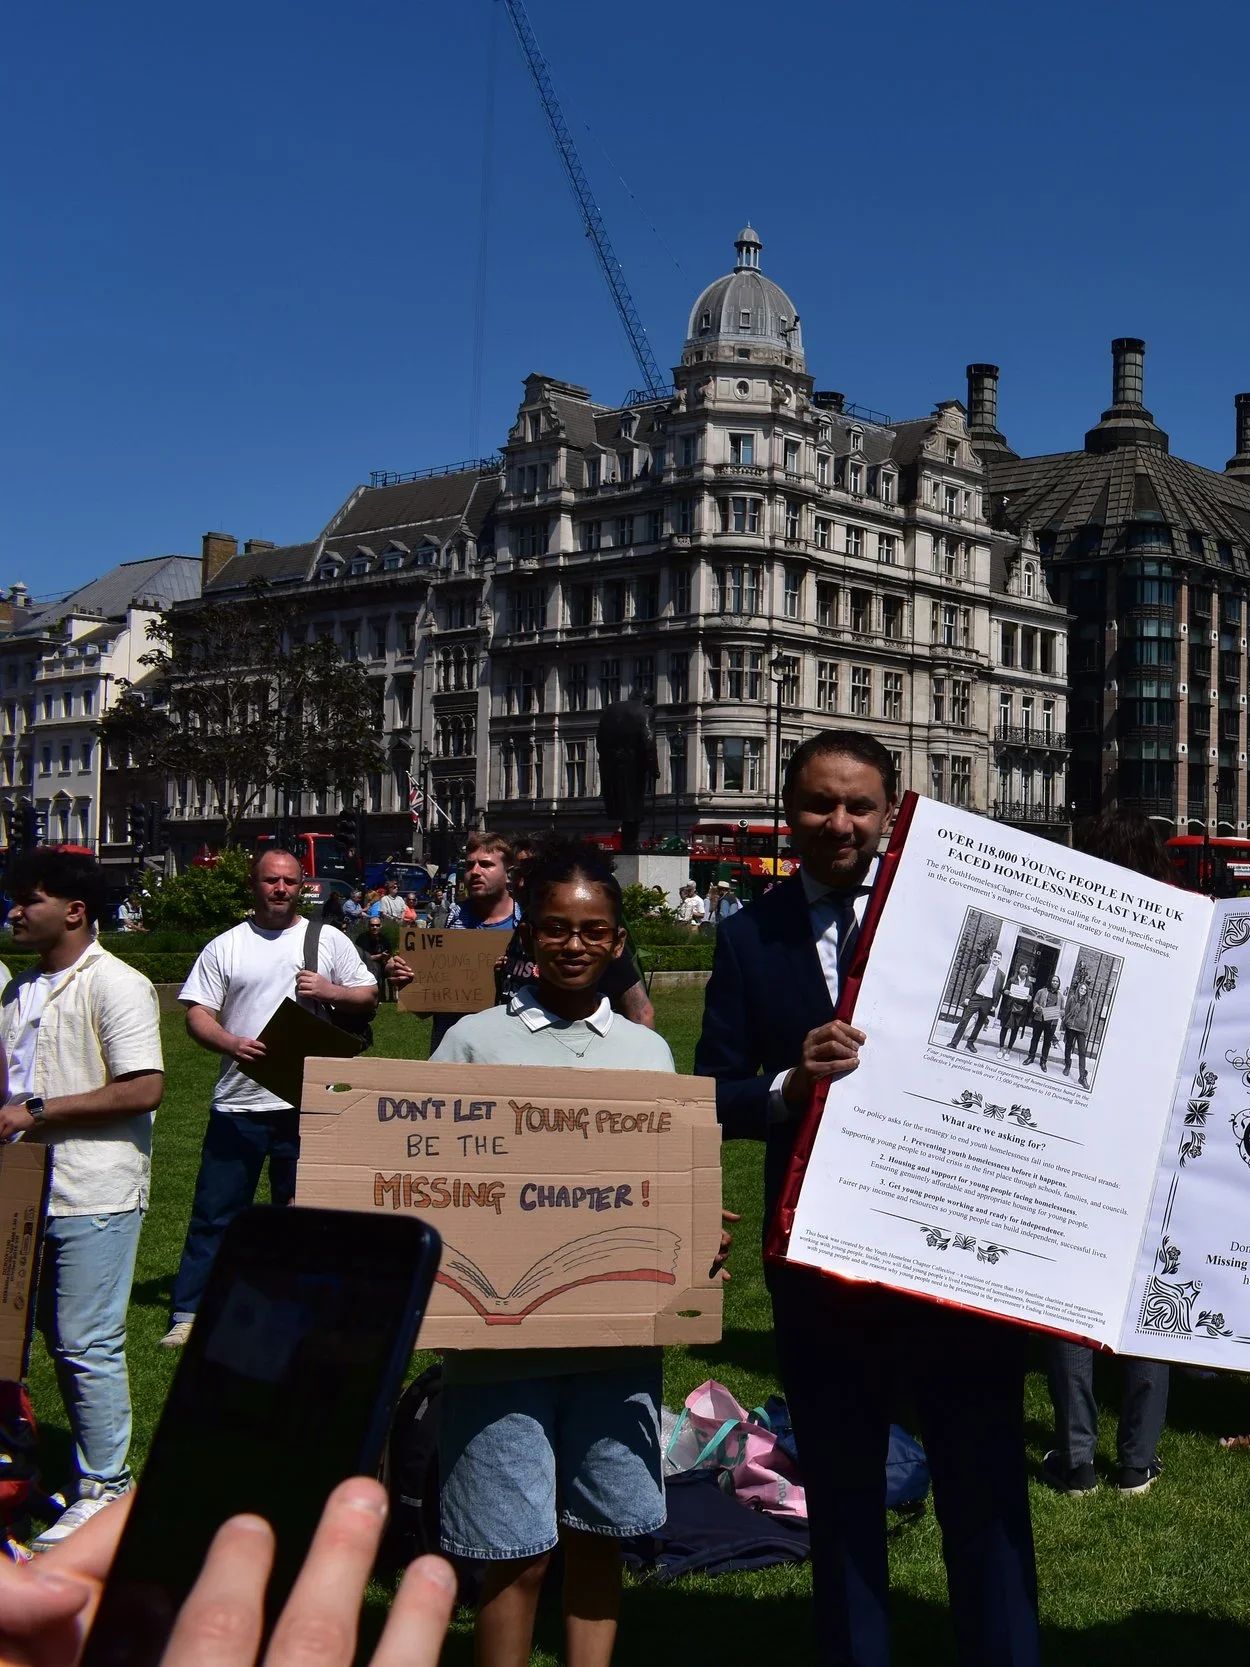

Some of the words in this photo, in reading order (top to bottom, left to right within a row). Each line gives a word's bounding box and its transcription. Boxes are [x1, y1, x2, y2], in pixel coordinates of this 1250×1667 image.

[926, 858, 939, 869] The
[940, 864, 1023, 897] #YouthHomelessChapter
[1024, 893, 1058, 910] Collective
[1066, 909, 1090, 922] calling
[1091, 915, 1101, 924] for
[1107, 923, 1153, 942] youth-specific
[1154, 938, 1178, 950] chapter
[937, 828, 974, 848] OVER
[978, 842, 1017, 863] 118,000
[1021, 856, 1066, 880] YOUNG
[1068, 874, 1117, 898] PEOPLE
[1120, 892, 1134, 904] IN
[1137, 897, 1162, 914] THE
[1165, 907, 1183, 921] UK
[948, 847, 990, 869] FACED
[994, 864, 1094, 906] HOMELESSNESS
[1097, 900, 1129, 917] LAST
[1132, 911, 1165, 930] YEAR
[927, 869, 935, 878] in
[936, 873, 947, 882] the
[996, 895, 1012, 904] new
[1012, 901, 1075, 926] cross-departmental
[1076, 922, 1103, 936] strategy
[1111, 934, 1125, 943] end
[1125, 937, 1170, 958] homelessness.
[430, 953, 471, 969] YOUNG
[422, 988, 484, 1001] THRIVE
[378, 1097, 445, 1122] DON'T
[454, 1100, 496, 1122] LET
[507, 1100, 589, 1139] YOUNG
[595, 1110, 672, 1134] PEOPLE
[406, 1134, 440, 1158] BE
[457, 1135, 509, 1157] THE
[853, 1105, 866, 1114] Our
[866, 1110, 886, 1121] policy
[887, 1117, 901, 1125] asks
[902, 1119, 912, 1128] for
[913, 1123, 923, 1131] the
[924, 1127, 949, 1139] strategy
[969, 1140, 988, 1150] youth
[988, 1144, 1029, 1162] homelessness
[1030, 1156, 1042, 1165] fall
[1042, 1159, 1055, 1169] into
[1055, 1164, 1071, 1174] three
[1071, 1170, 1097, 1182] practical
[1098, 1178, 1121, 1189] strands:
[941, 1113, 965, 1127] What
[966, 1123, 981, 1132] are
[983, 1128, 996, 1136] we
[997, 1132, 1026, 1147] asking
[1027, 1139, 1046, 1151] for?
[841, 1127, 876, 1143] Supporting
[876, 1138, 897, 1149] young
[897, 1144, 919, 1154] people
[927, 1153, 946, 1162] avoid
[945, 1158, 963, 1167] crisis
[963, 1161, 971, 1170] in
[971, 1164, 982, 1173] the
[982, 1167, 995, 1176] first
[995, 1172, 1013, 1181] place
[1013, 1176, 1037, 1189] through
[1038, 1185, 1062, 1197] schools,
[1063, 1191, 1089, 1205] families,
[1089, 1200, 1102, 1208] and
[1102, 1204, 1129, 1215] councils.
[888, 1156, 916, 1170] Housing
[916, 1165, 930, 1173] and
[931, 1169, 957, 1181] support
[958, 1175, 968, 1184] for
[968, 1180, 990, 1191] young
[990, 1186, 1012, 1196] people
[1013, 1191, 1033, 1204] facing
[1034, 1198, 1077, 1215] homelessness.
[911, 1137, 946, 1154] Preventing
[947, 1149, 966, 1159] youth
[967, 1154, 1010, 1171] homelessness
[1011, 1166, 1031, 1177] before
[1039, 1174, 1067, 1188] happens.
[373, 1173, 505, 1215] MISSING
[838, 1176, 858, 1187] Fairer
[858, 1184, 871, 1192] pay
[871, 1186, 895, 1198] income
[896, 1194, 909, 1202] and
[909, 1198, 938, 1210] resources
[947, 1209, 968, 1220] young
[968, 1215, 990, 1225] people
[1003, 1223, 1020, 1233] build
[1020, 1228, 1058, 1245] independent,
[1060, 1241, 1091, 1254] successful
[1091, 1248, 1108, 1259] lives.
[870, 1160, 899, 1175] Ensuring
[899, 1170, 931, 1184] genuinely
[931, 1178, 963, 1192] affordable
[963, 1188, 976, 1196] and
[976, 1192, 1011, 1206] appropriate
[1012, 1200, 1036, 1215] housing
[1037, 1208, 1047, 1216] for
[1047, 1212, 1067, 1223] young
[1067, 1218, 1090, 1229] people.
[879, 1178, 885, 1186] 3.
[888, 1181, 901, 1190] Get
[901, 1186, 923, 1197] young
[923, 1192, 945, 1202] people
[947, 1199, 974, 1212] working
[975, 1207, 988, 1215] and
[989, 1211, 1008, 1221] ready
[1008, 1215, 1019, 1224] for
[1020, 1218, 1065, 1237] independence.
[1206, 1254, 1247, 1271] Missing
